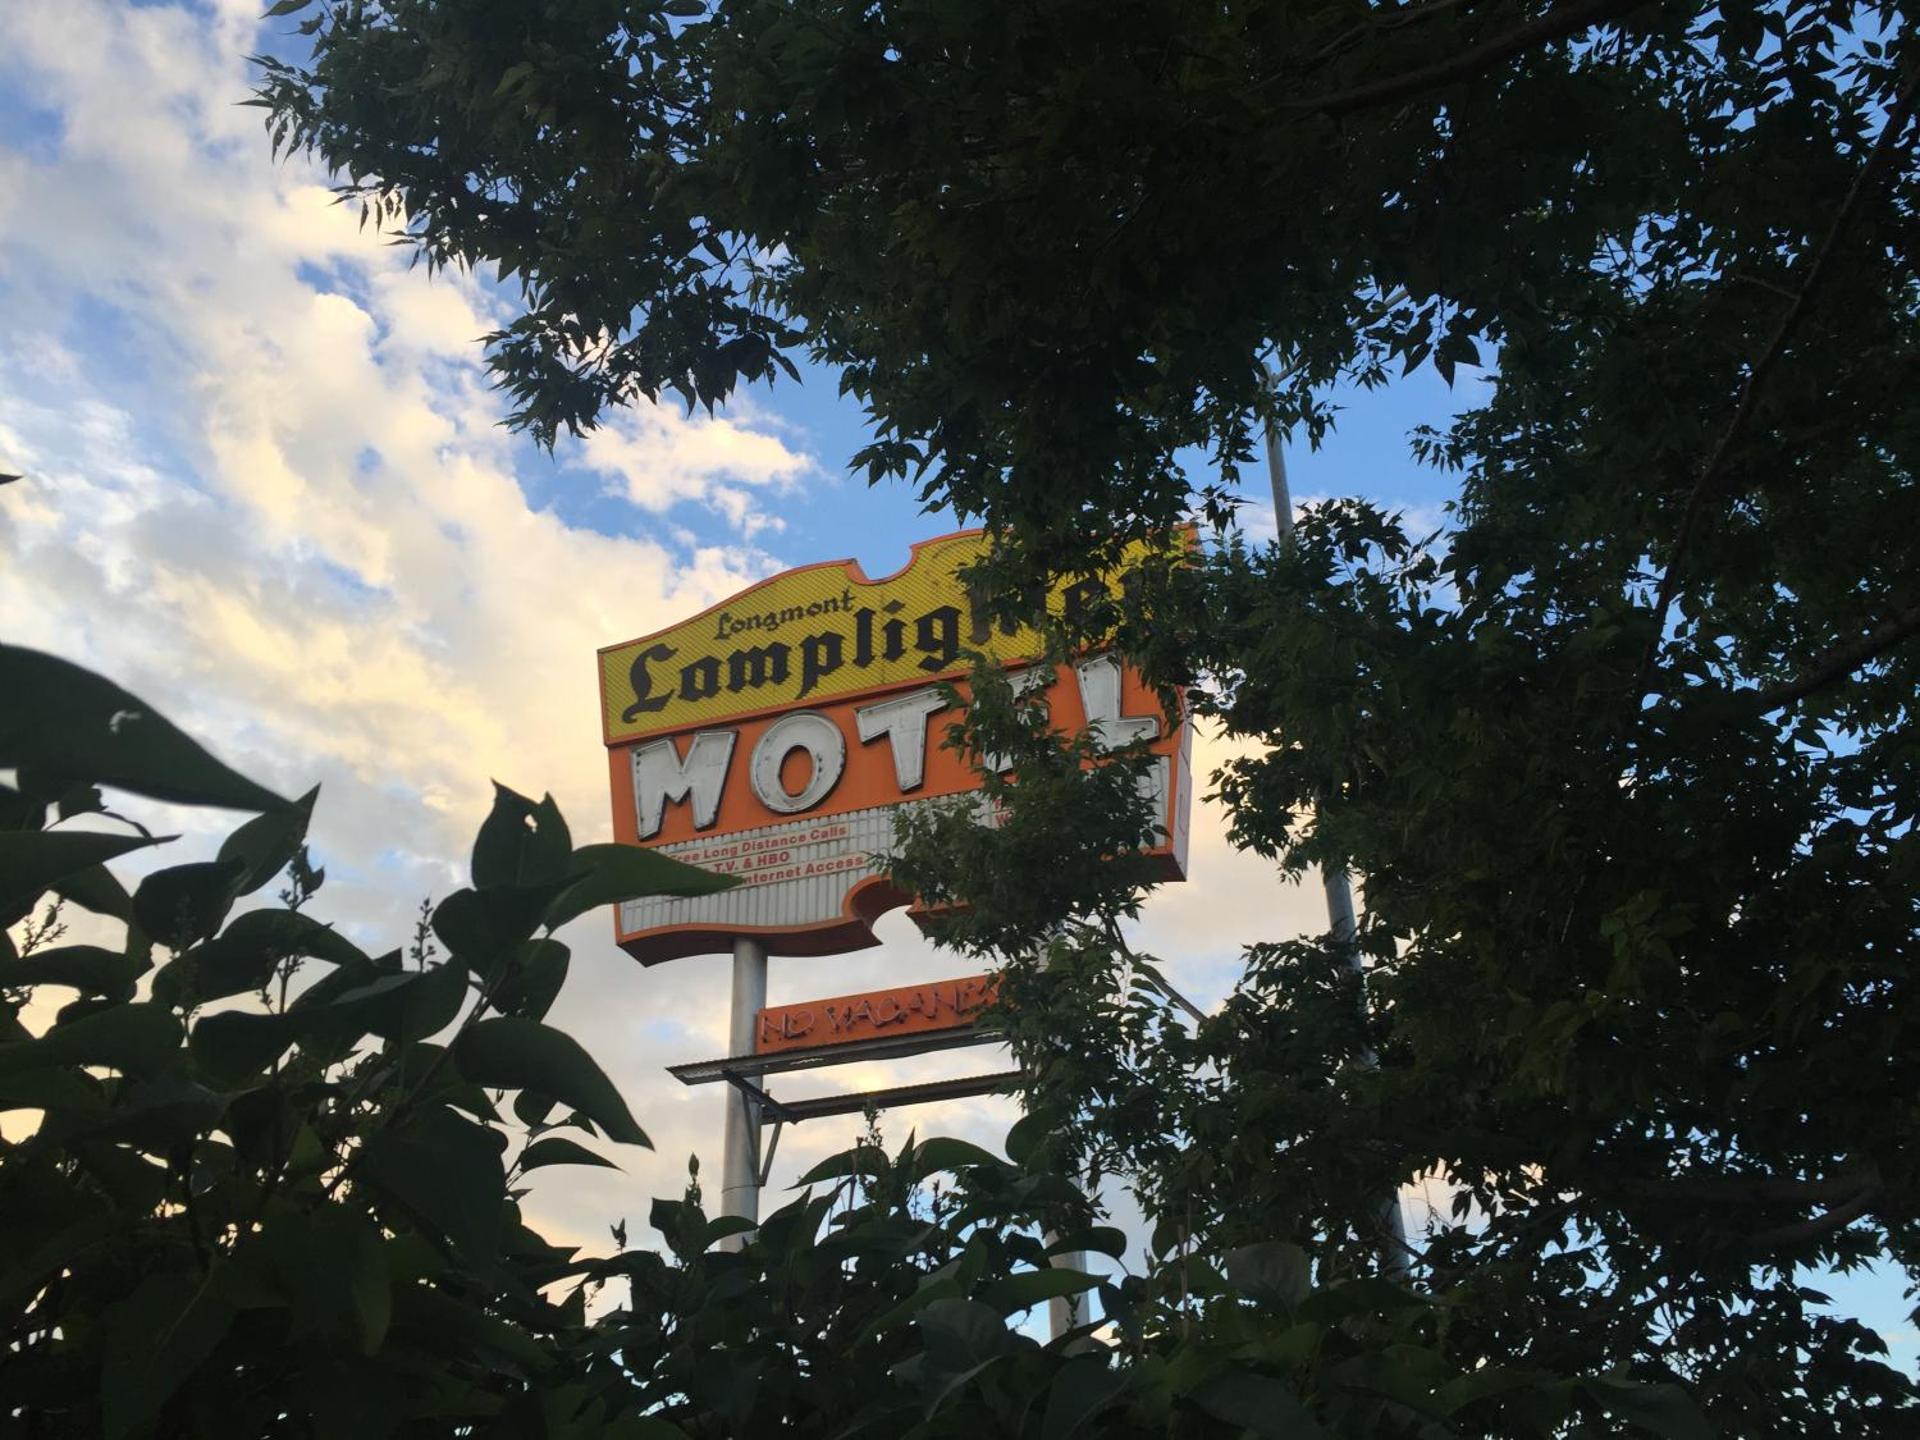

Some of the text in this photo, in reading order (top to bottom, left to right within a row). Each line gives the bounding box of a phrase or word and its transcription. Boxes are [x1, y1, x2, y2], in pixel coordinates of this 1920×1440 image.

[714, 587, 856, 641] Longmont
[621, 556, 1160, 724] Lamplige
[704, 845, 738, 860] Long
[742, 834, 806, 852] Distance
[810, 827, 846, 840] Calls
[743, 857, 754, 869] &
[758, 851, 790, 867] HBO
[742, 854, 865, 885] nternet Access
[762, 1010, 814, 1043] NO
